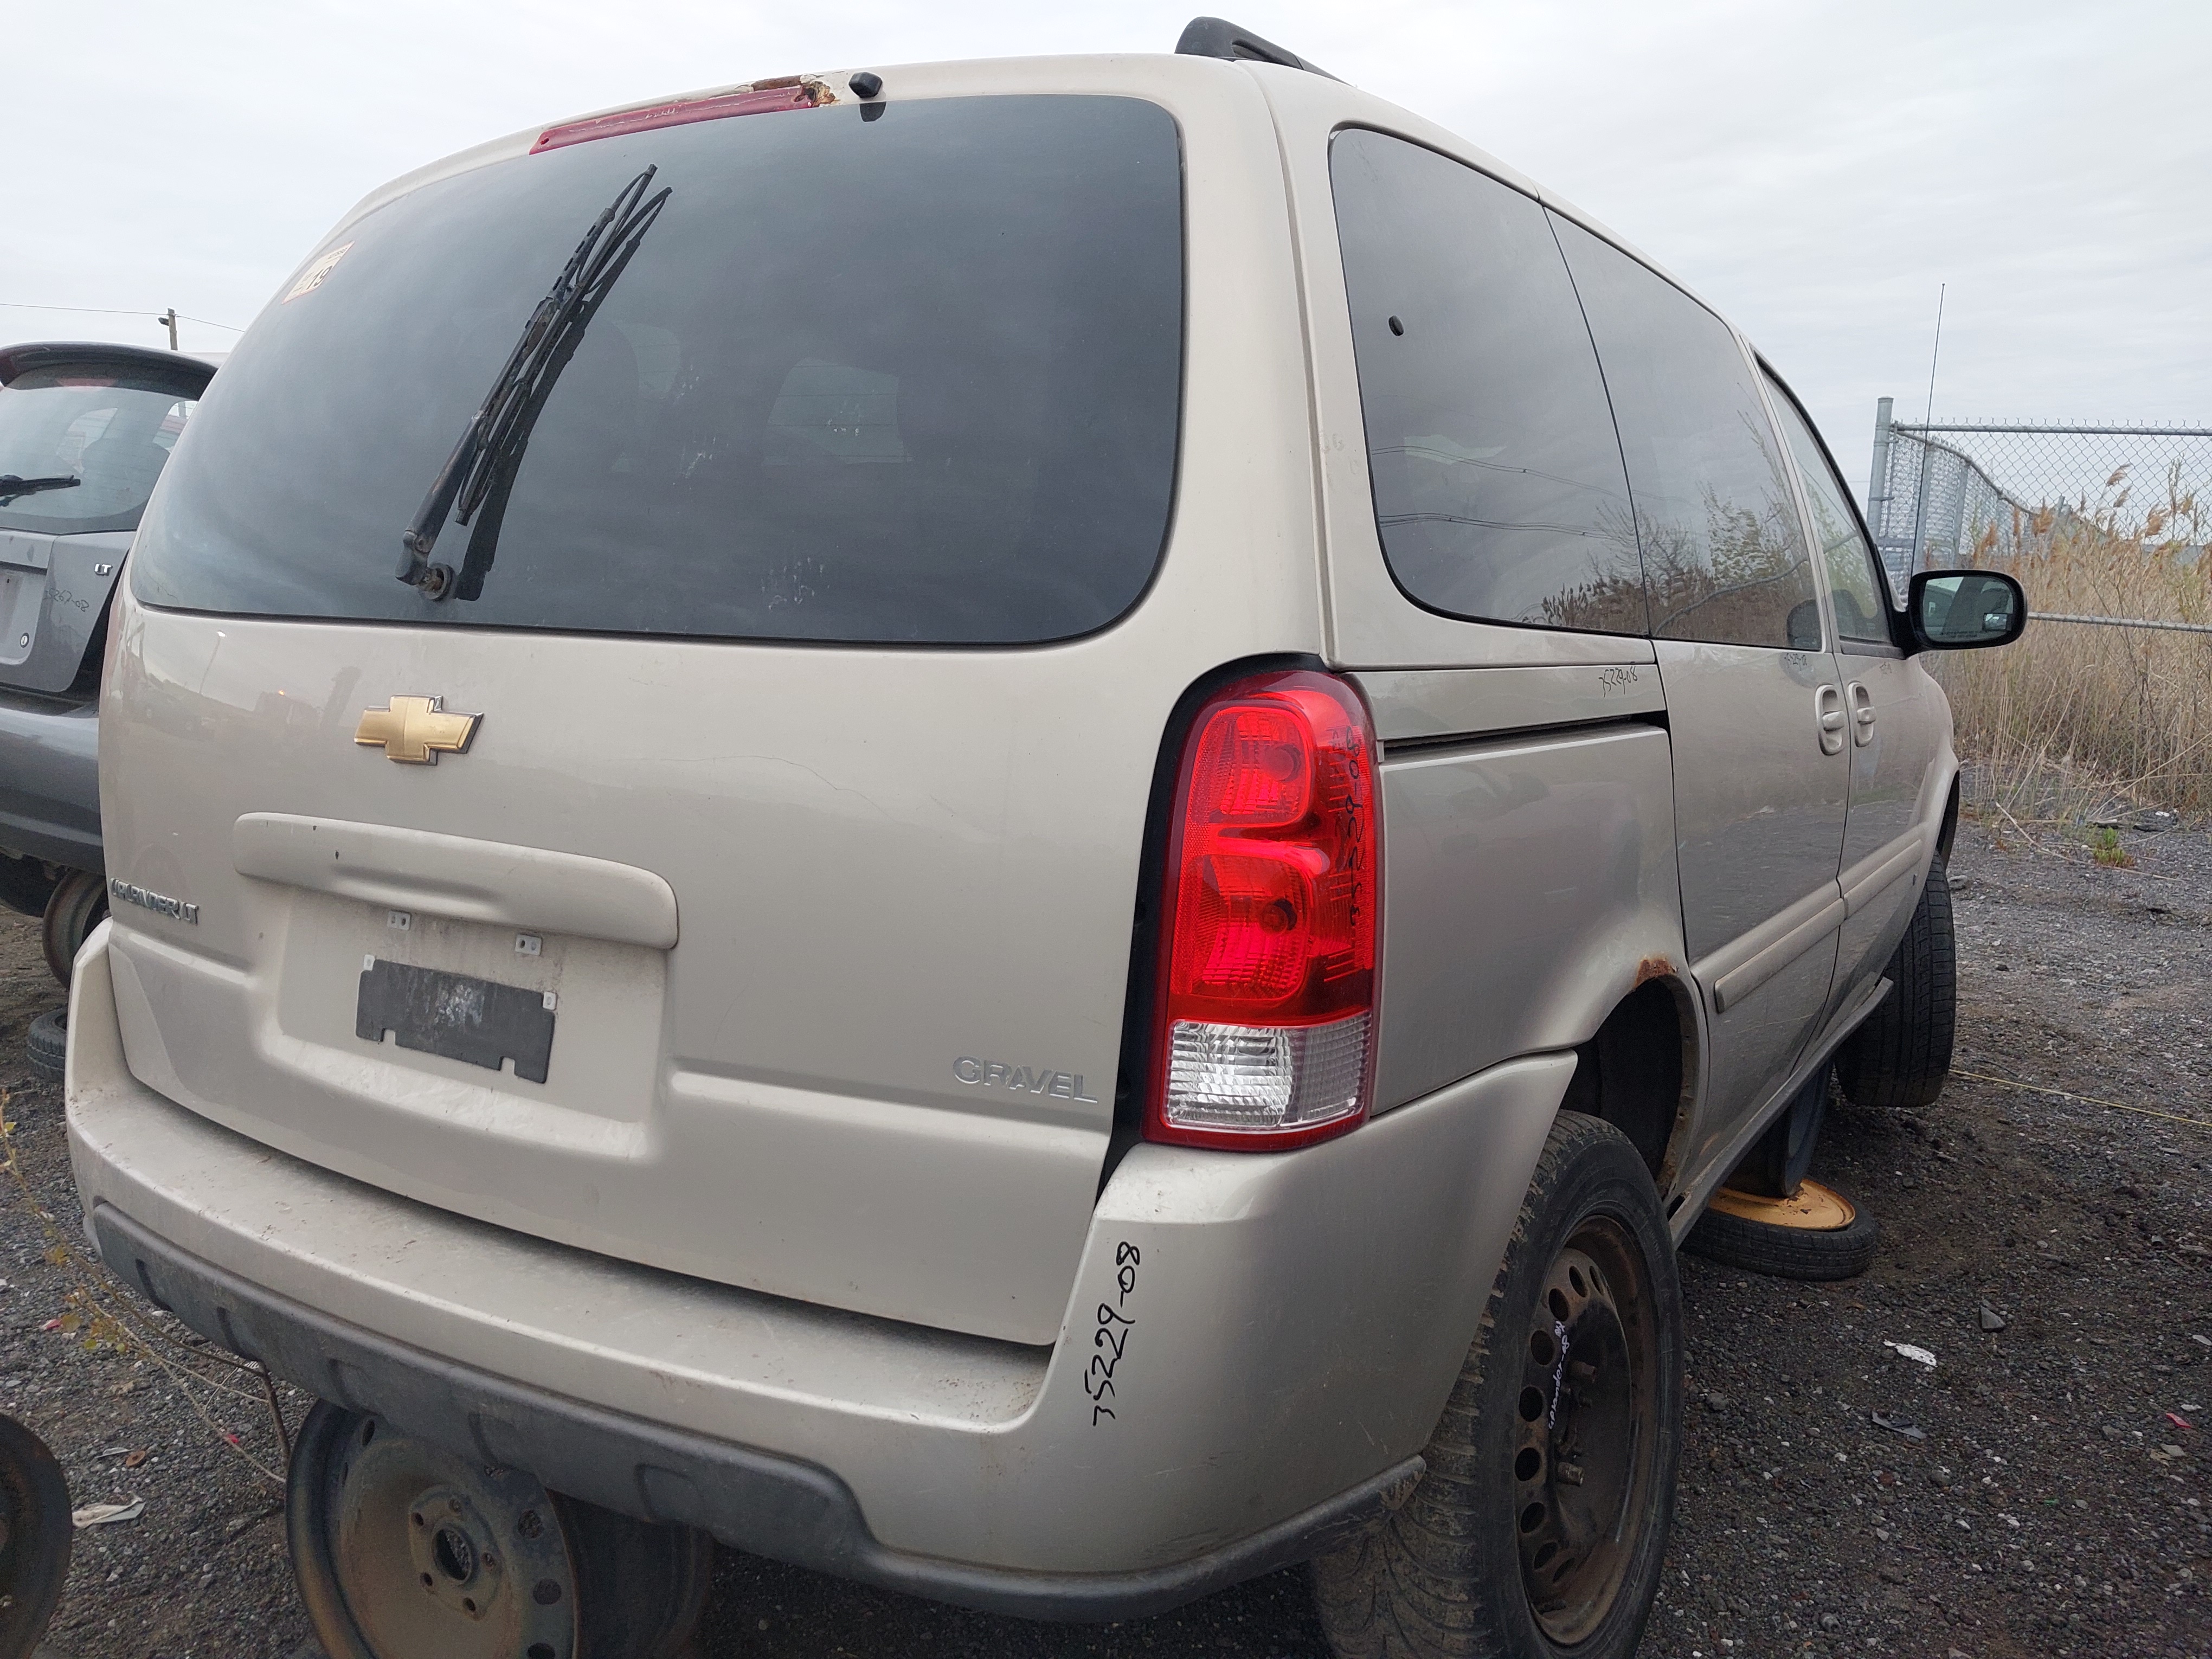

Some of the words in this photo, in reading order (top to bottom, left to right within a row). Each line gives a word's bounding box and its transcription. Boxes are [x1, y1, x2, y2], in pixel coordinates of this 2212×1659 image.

[94, 563, 113, 576] LT
[1598, 666, 1638, 698] 35229-08
[110, 878, 181, 921] UPLANDER
[179, 900, 200, 924] LT
[952, 1056, 1098, 1104] GRAVEL
[1084, 1241, 1140, 1426] 35229-08
